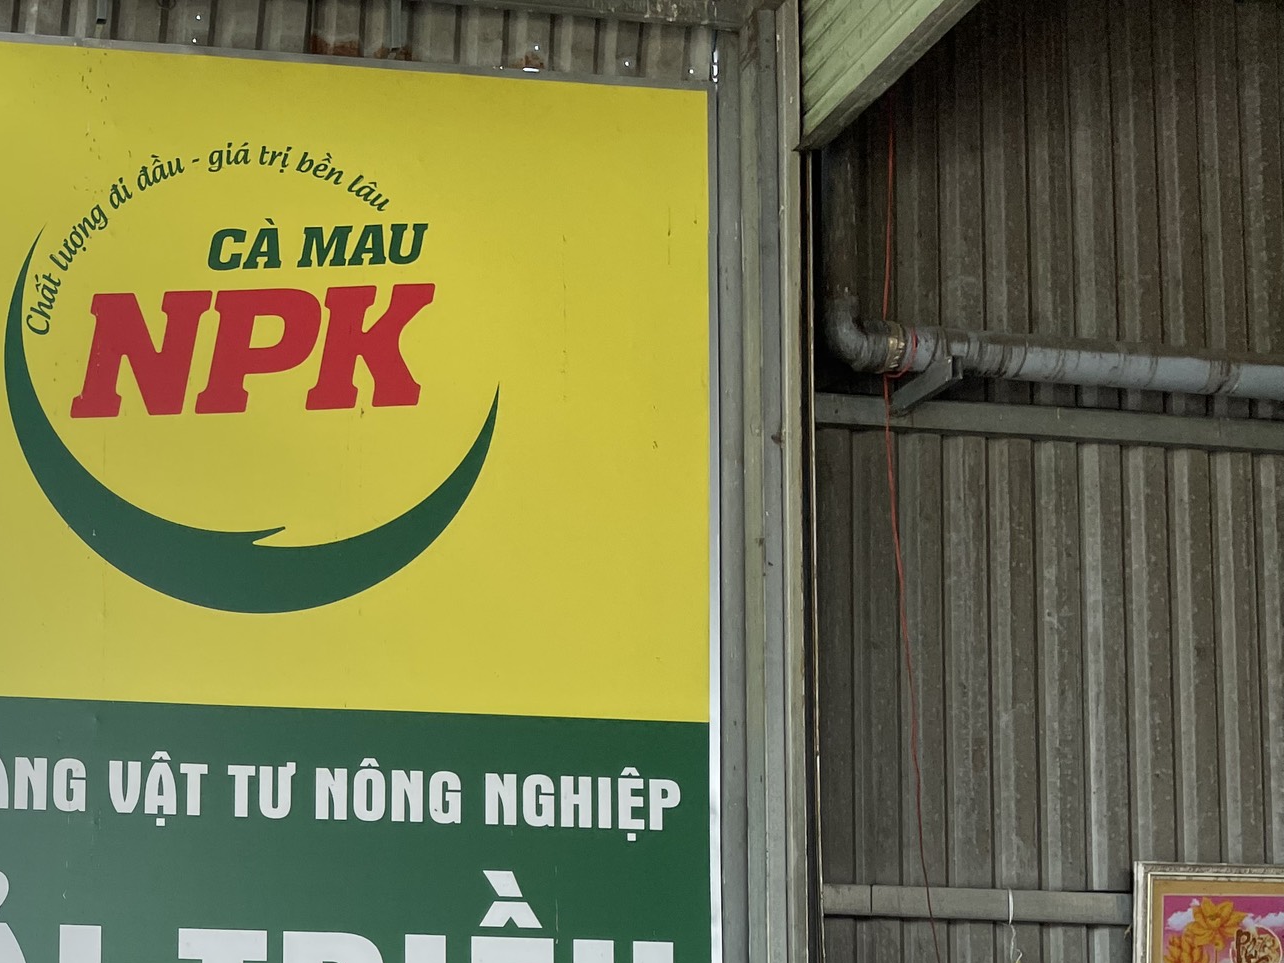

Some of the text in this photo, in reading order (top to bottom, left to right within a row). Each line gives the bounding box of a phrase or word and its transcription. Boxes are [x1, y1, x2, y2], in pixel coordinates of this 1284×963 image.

[26, 274, 61, 335] Chất
[49, 204, 108, 271] lượng
[109, 177, 133, 210] đi
[137, 154, 185, 191] đầu
[208, 142, 250, 172] giá
[258, 145, 292, 173] trị
[296, 152, 343, 186] bền
[347, 174, 390, 212] lâu
[207, 218, 429, 271] CÀ MAU
[69, 282, 436, 419] NPK
[109, 751, 210, 827] VẬT
[227, 761, 297, 820] TƯ
[315, 758, 463, 825] NÔNG
[484, 765, 682, 842] NGHIỆP
